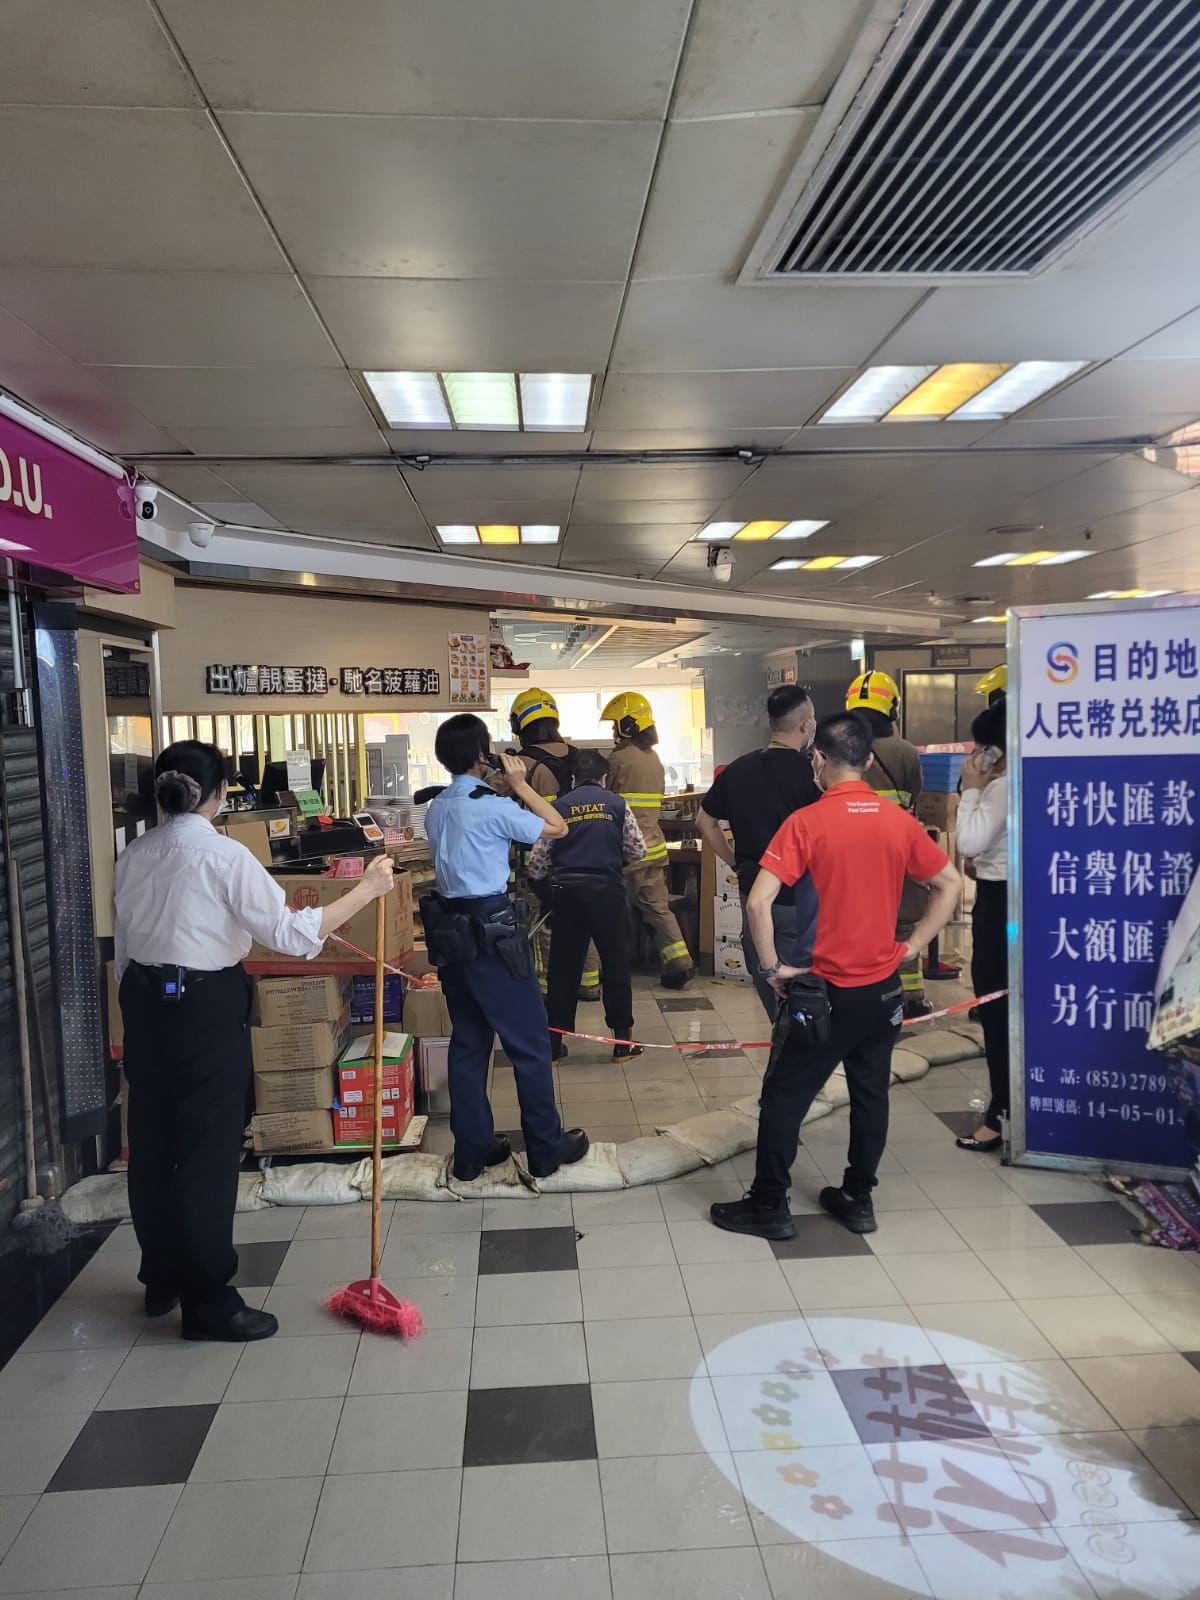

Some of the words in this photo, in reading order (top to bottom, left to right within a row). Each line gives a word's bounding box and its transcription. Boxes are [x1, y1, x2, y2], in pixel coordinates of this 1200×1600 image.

[1094, 638, 1199, 682] 目的地
[1046, 780, 1195, 827] 特快匯款
[1047, 850, 1194, 897] 信譽保證
[1030, 1067, 1045, 1083] 電
